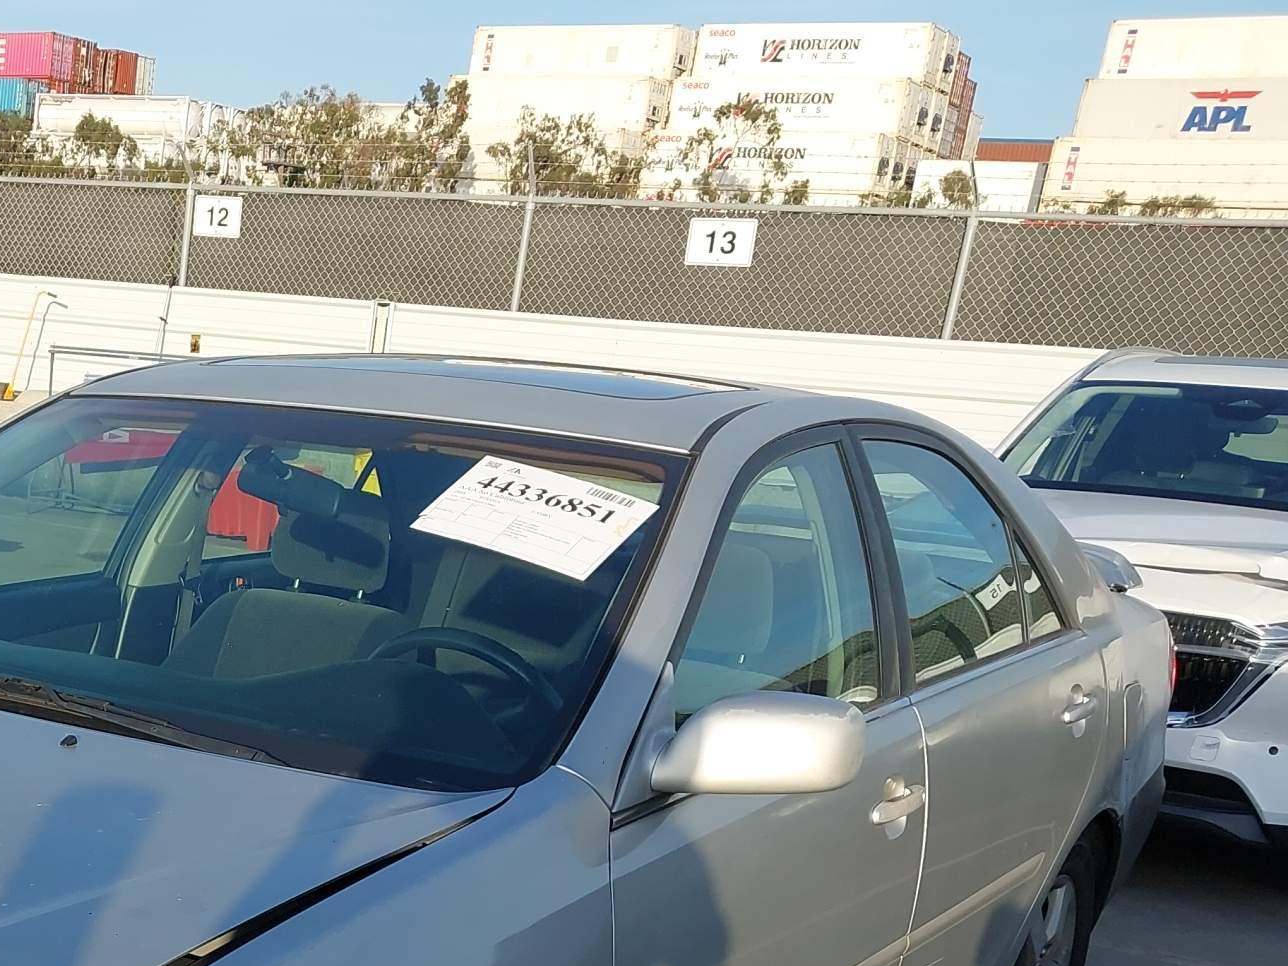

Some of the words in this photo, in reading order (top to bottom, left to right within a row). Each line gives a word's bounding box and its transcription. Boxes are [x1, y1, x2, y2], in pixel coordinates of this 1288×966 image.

[790, 39, 861, 50] HORIZON
[786, 52, 848, 60] LINES
[682, 81, 709, 89] seaco
[763, 92, 834, 104] HORIZON
[1180, 105, 1251, 132] APL
[736, 147, 806, 159] HORIZON
[207, 206, 229, 227] 12
[706, 230, 737, 254] 13
[477, 476, 616, 524] 44336851
